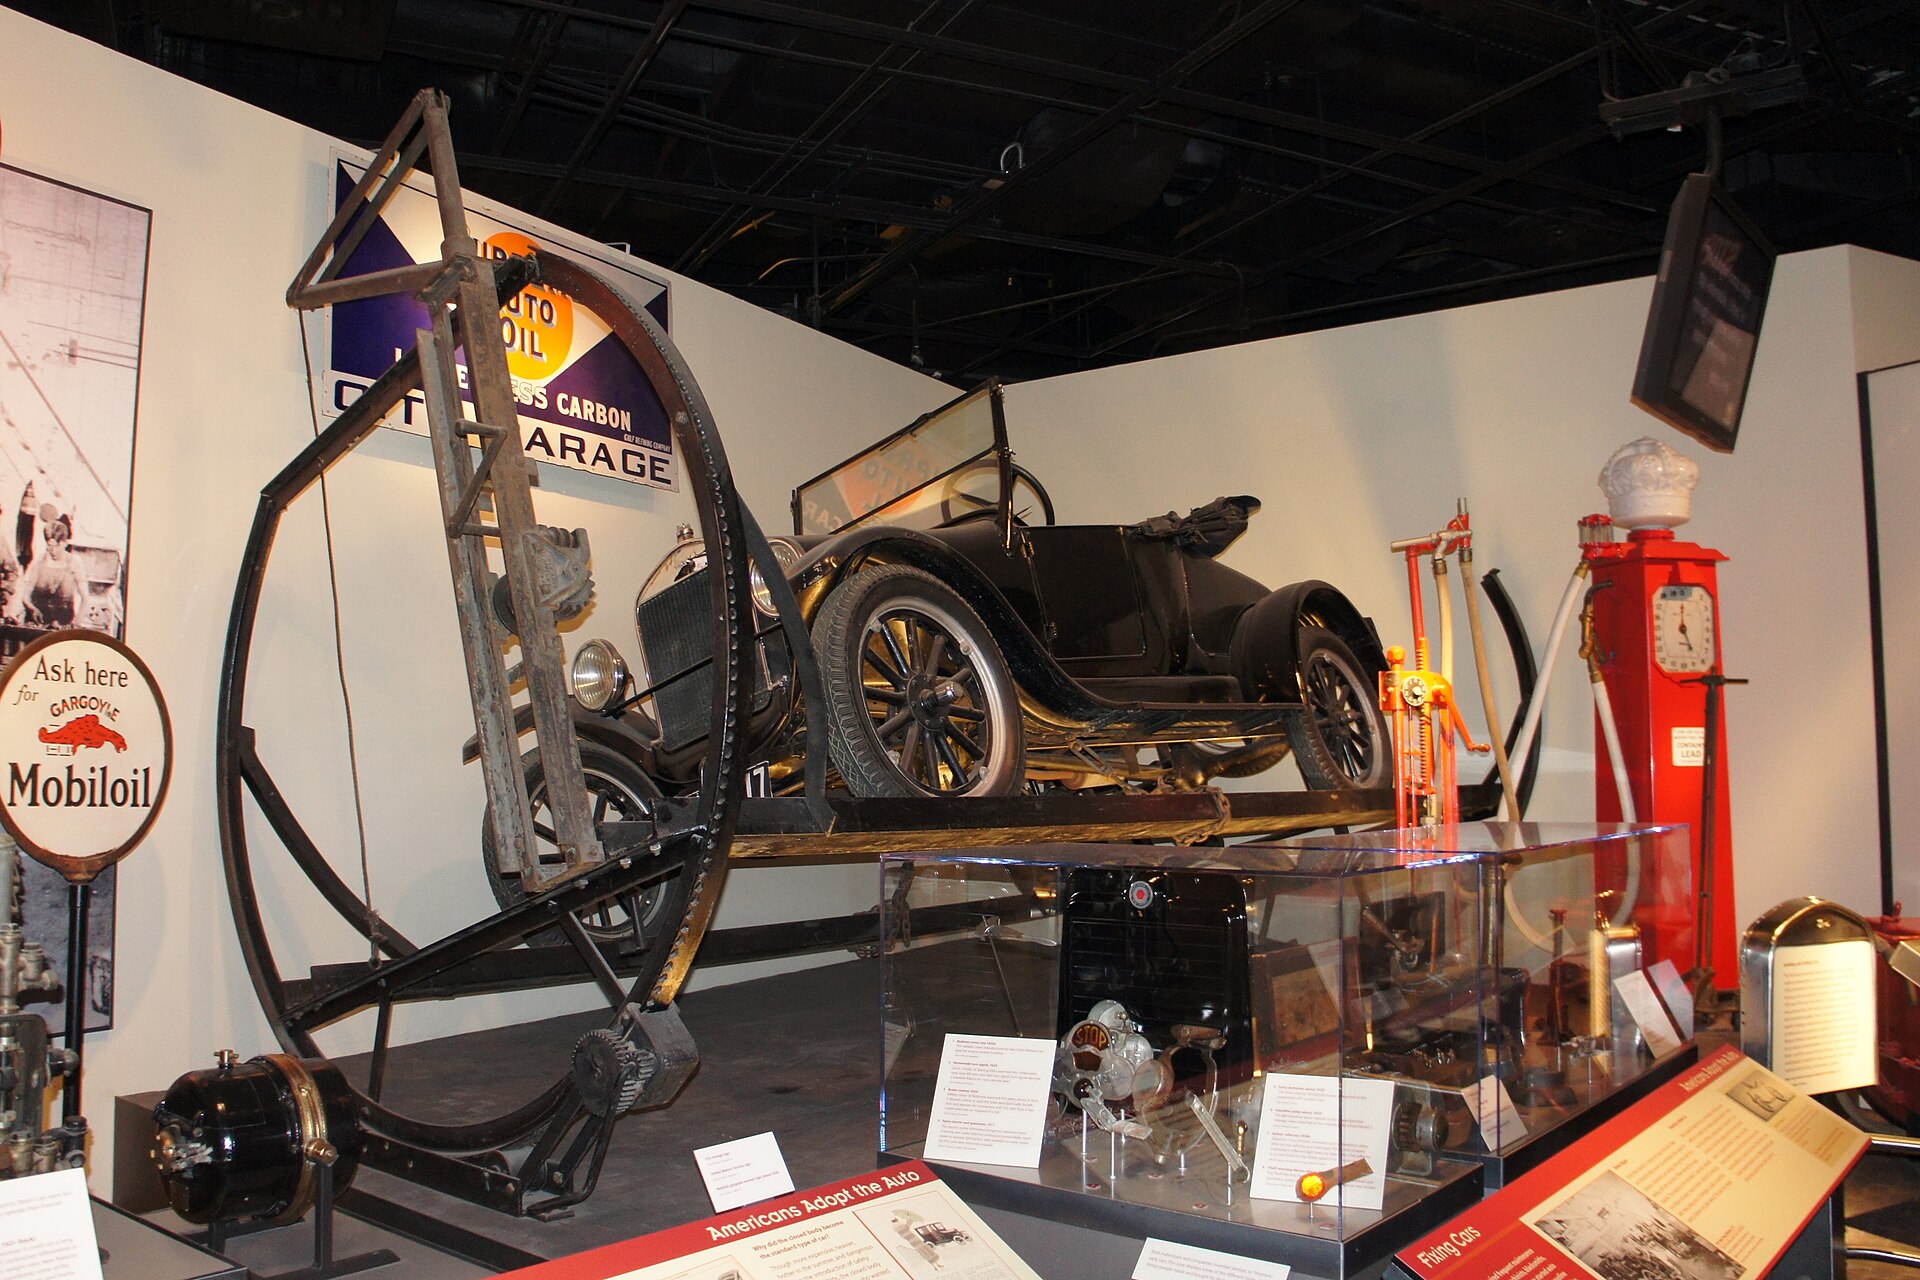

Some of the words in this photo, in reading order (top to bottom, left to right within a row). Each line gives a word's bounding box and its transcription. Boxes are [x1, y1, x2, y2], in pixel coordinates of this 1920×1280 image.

[503, 290, 556, 327] UTO
[500, 316, 547, 362] OIL
[556, 392, 632, 432] CARBON
[623, 433, 635, 444] GULF
[524, 426, 672, 485] ARAGE
[34, 655, 75, 683] Ask
[85, 660, 129, 687] here
[13, 684, 39, 706] for
[50, 695, 120, 722] GARGOYLE
[1681, 750, 1702, 758] LEAD
[8, 762, 151, 808] Mobiloil
[1075, 1025, 1107, 1049] STOP
[706, 1203, 802, 1241] Americans
[800, 1188, 854, 1214] Adopt
[853, 1181, 883, 1198] the
[881, 1170, 920, 1190] Auto
[752, 1244, 767, 1252] Why
[767, 1240, 778, 1248] did
[789, 1231, 807, 1241] closed
[807, 1227, 822, 1237] body
[822, 1220, 844, 1231] become
[771, 1244, 798, 1256] standard
[798, 1240, 811, 1250] type
[1417, 1241, 1461, 1268] Fixing
[1450, 1226, 1481, 1247] Cars
